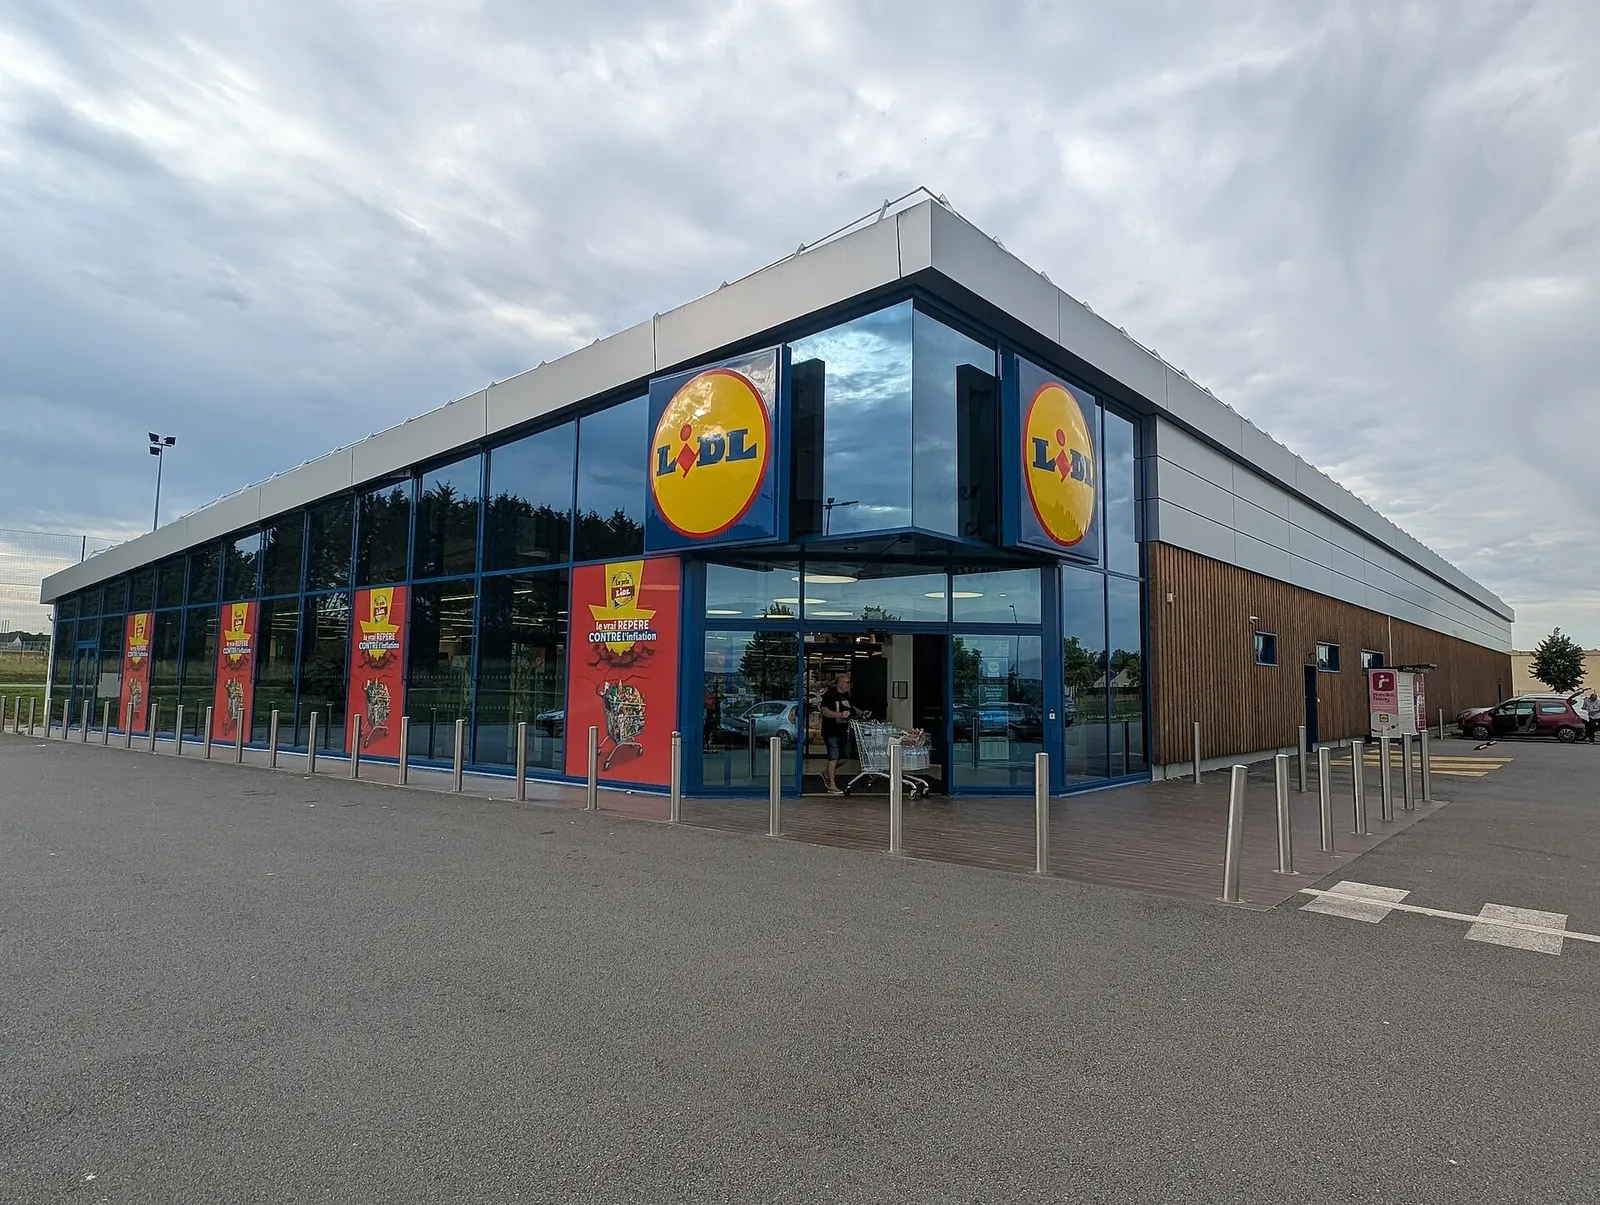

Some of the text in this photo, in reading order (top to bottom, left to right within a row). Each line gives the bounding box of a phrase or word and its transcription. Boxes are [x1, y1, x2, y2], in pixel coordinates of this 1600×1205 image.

[603, 621, 617, 630] vrai
[589, 631, 656, 642] CONTRE l'inflation
